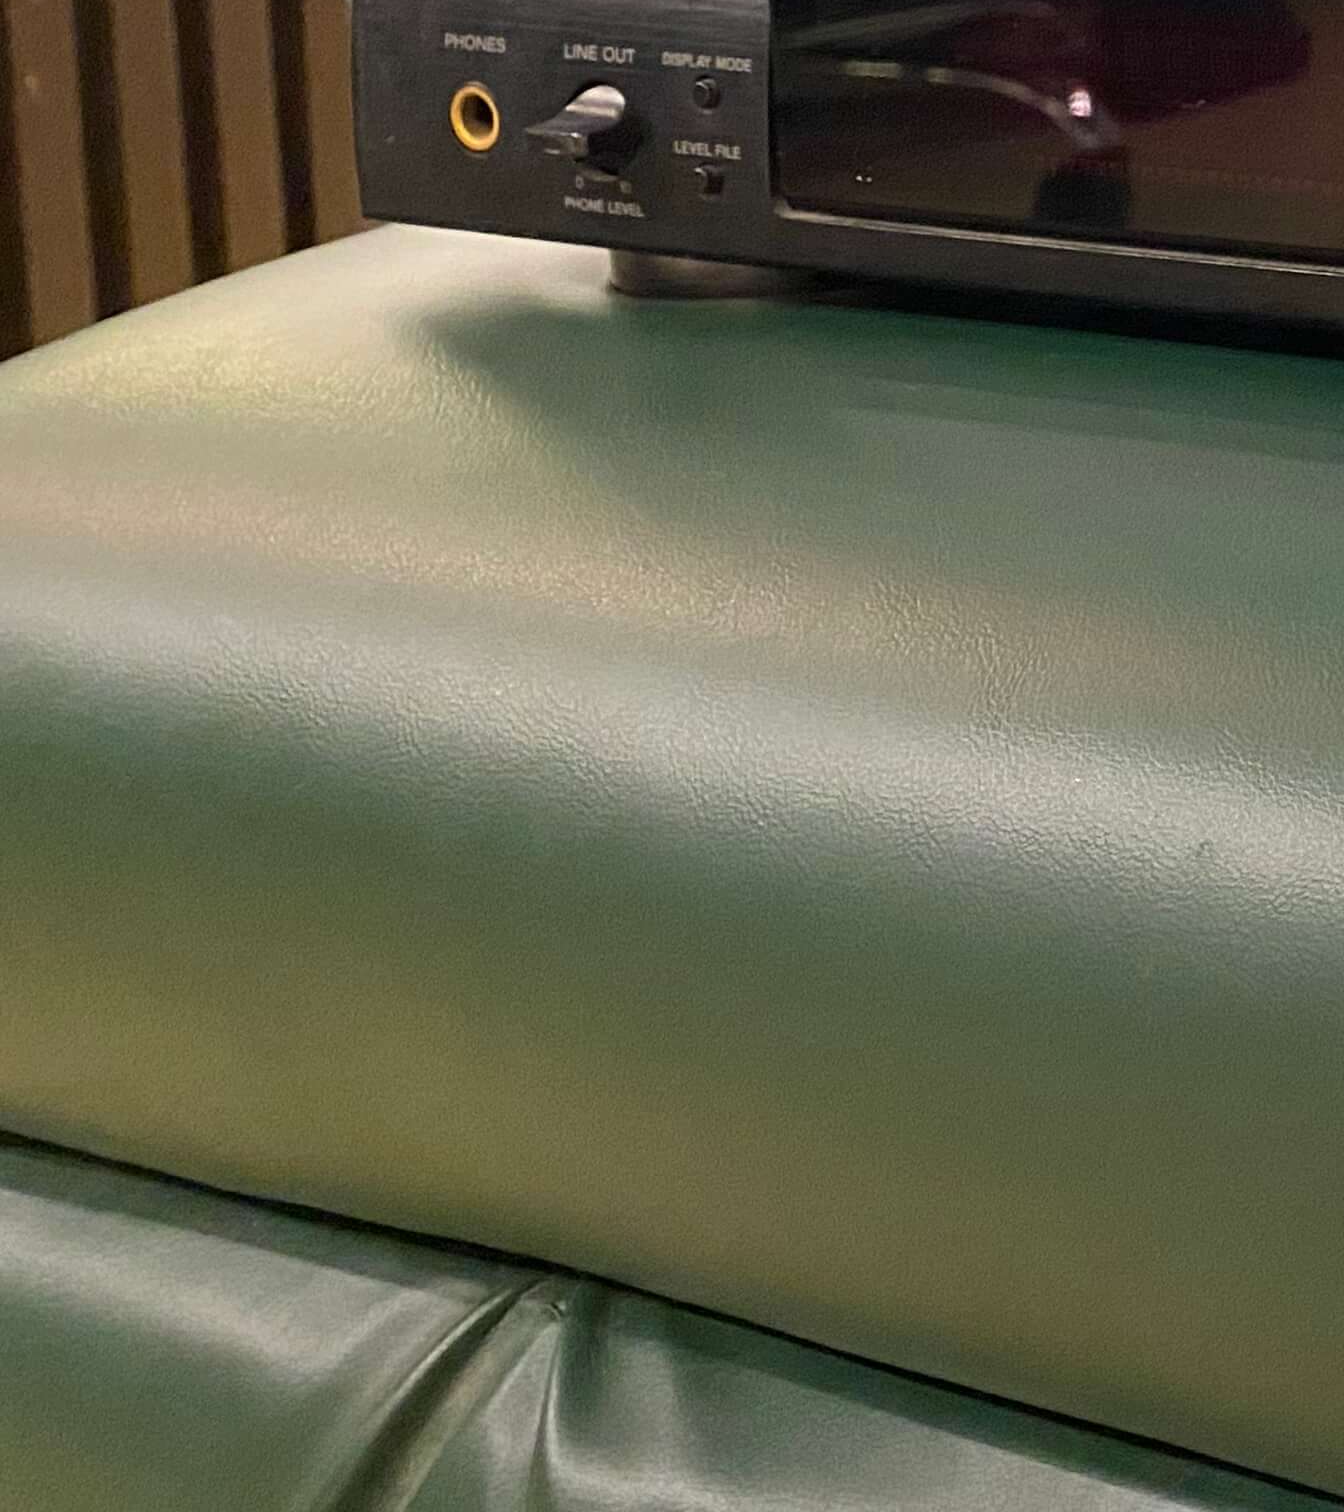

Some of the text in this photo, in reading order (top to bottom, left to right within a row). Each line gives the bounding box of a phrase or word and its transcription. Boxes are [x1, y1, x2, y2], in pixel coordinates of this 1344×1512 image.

[444, 33, 506, 53] PHONES
[564, 43, 636, 65] LINE OUT
[661, 51, 752, 73] DISPLAY MODE
[673, 140, 741, 160] LEVEL FILE
